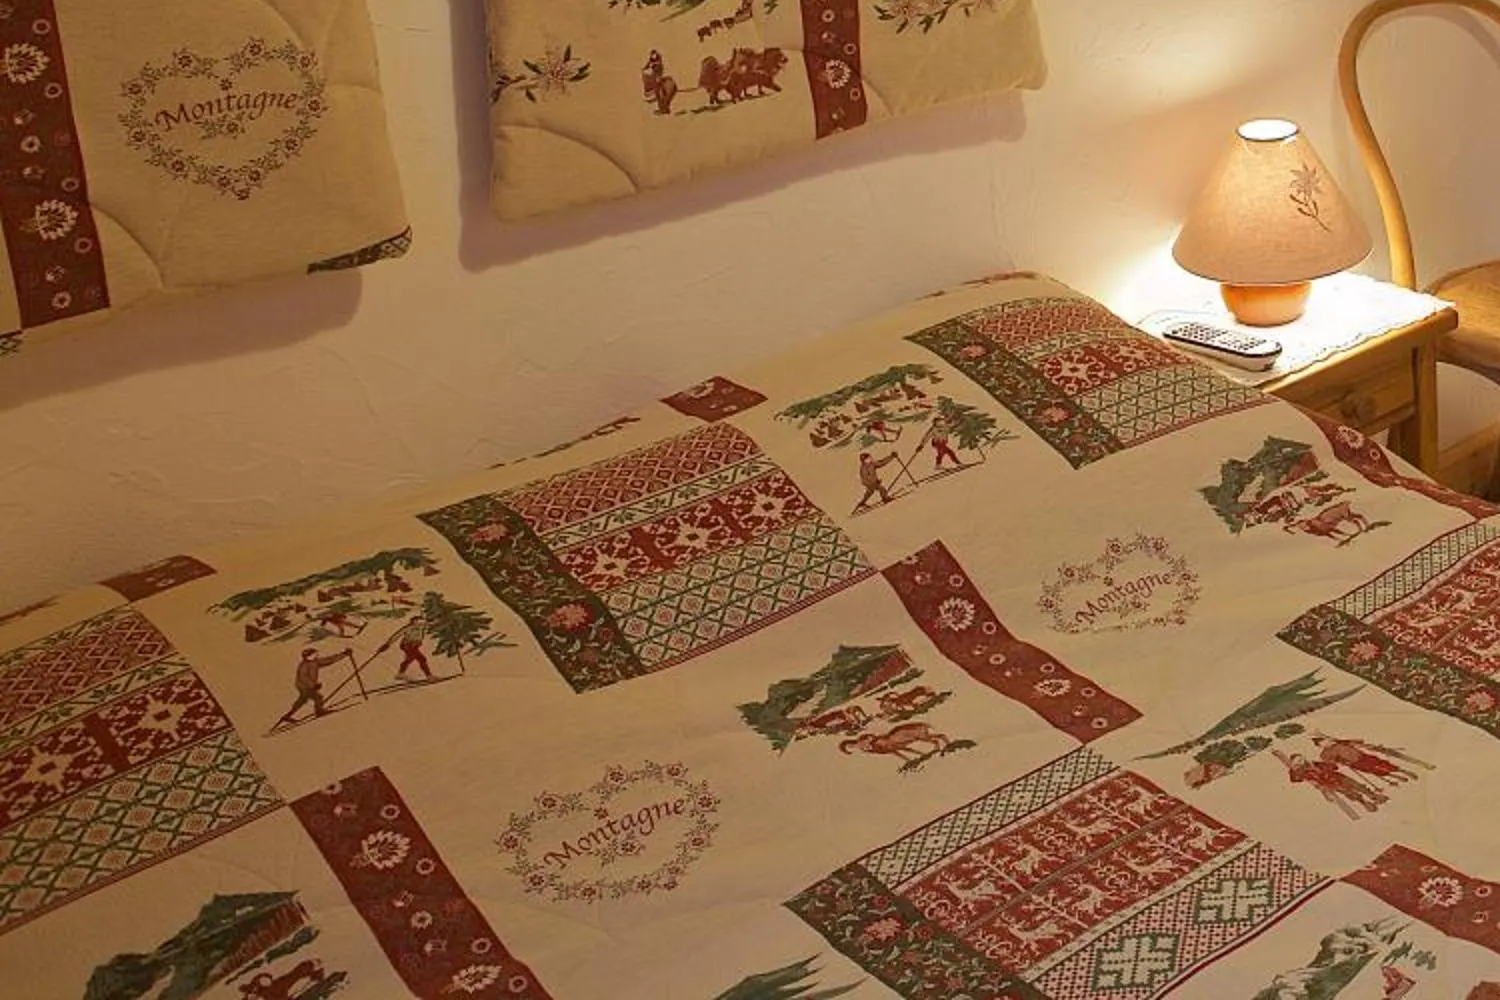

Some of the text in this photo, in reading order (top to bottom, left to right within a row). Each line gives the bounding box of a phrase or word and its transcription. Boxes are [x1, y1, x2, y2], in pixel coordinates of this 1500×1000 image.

[155, 90, 298, 131] Montagne
[1075, 572, 1173, 624] Montagne
[544, 798, 685, 868] Montagne
